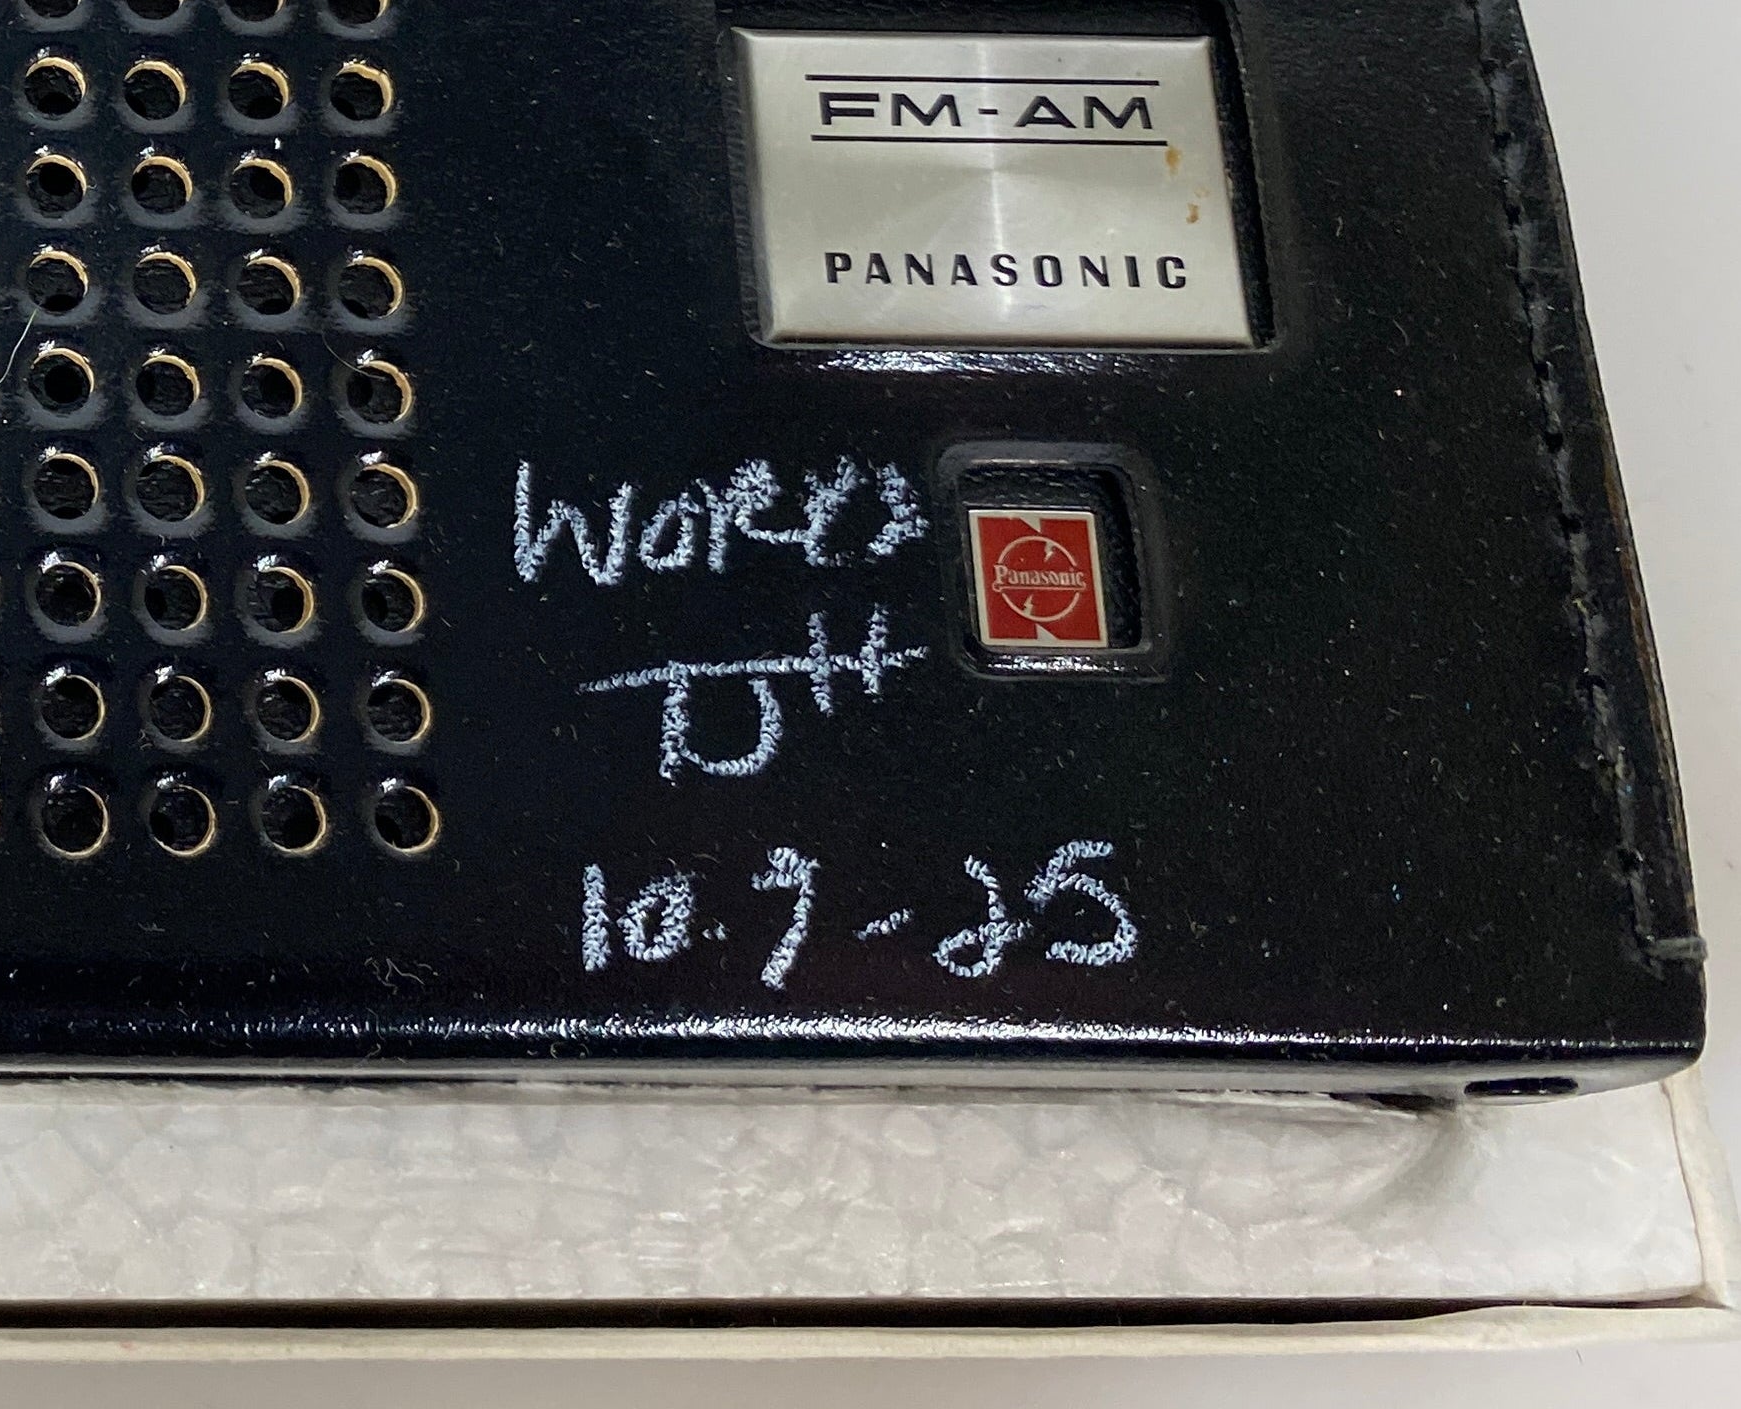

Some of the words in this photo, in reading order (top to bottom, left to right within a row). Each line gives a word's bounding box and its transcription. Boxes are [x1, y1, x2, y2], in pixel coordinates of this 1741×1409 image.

[819, 92, 1154, 130] FM-AM
[825, 252, 1187, 289] PANASONIC
[993, 563, 1087, 588] Panasonic
